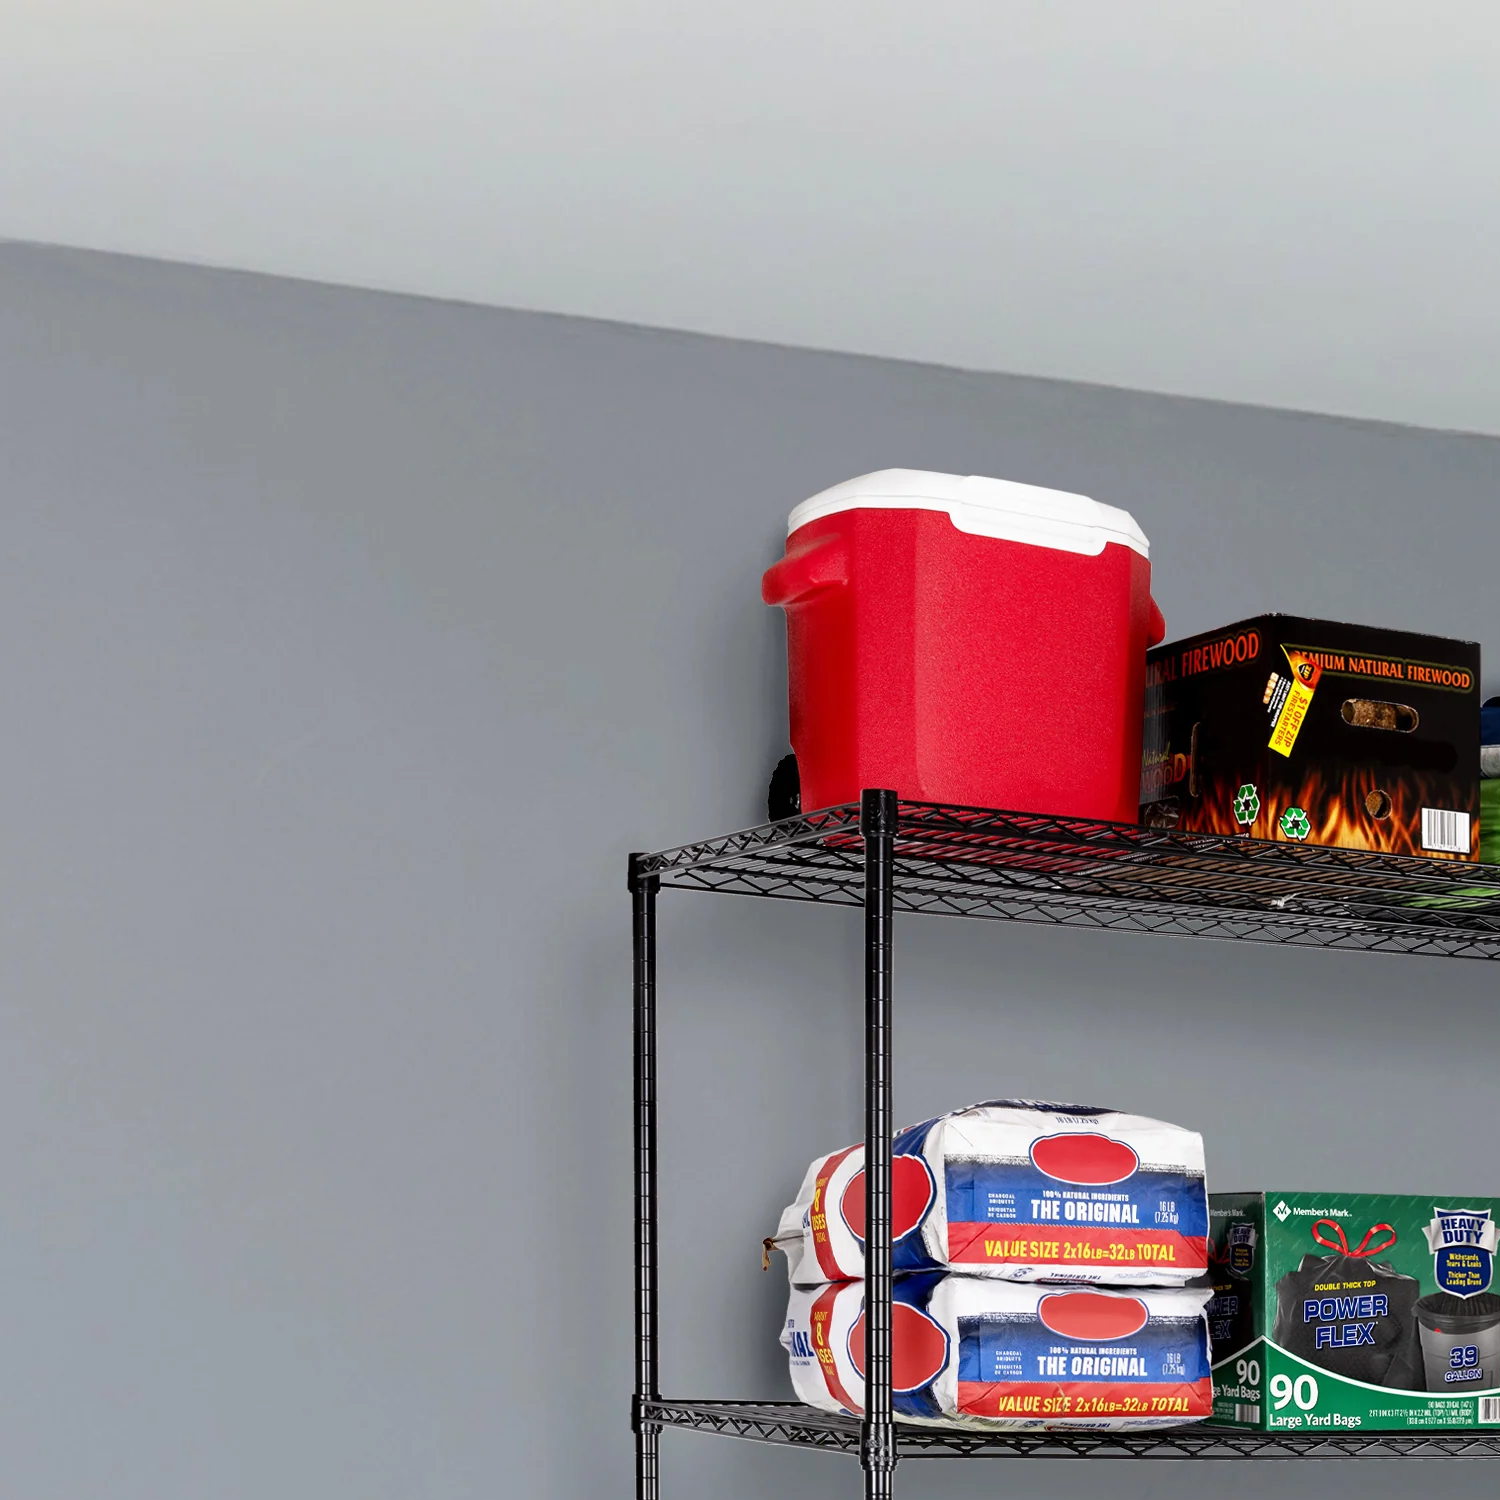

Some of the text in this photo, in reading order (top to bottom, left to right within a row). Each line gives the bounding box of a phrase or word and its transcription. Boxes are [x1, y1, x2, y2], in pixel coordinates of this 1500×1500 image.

[1181, 632, 1259, 677] FIREWOOD
[1297, 651, 1470, 688] MIUM NATURAL FIREWOOD
[1275, 690, 1300, 746] FIRESTARTERS
[1284, 696, 1308, 748] $1 OFF ZIP
[814, 1188, 821, 1212] 8
[1043, 1190, 1130, 1202] 100% NATURAL INGREDIENTS
[1031, 1199, 1140, 1224] THE ORIGINAL
[1160, 1201, 1175, 1212] 16 LB
[1293, 1208, 1329, 1216] Member's
[812, 1213, 826, 1231] USES
[1155, 1211, 1179, 1224] (7.25 kg)
[1441, 1218, 1485, 1231] HEAVY
[1233, 1234, 1250, 1243] DUTY
[1443, 1229, 1483, 1244] DUTY
[985, 1240, 1027, 1258] VALUE
[1030, 1241, 1059, 1258] SIZE
[1137, 1243, 1176, 1261] TOTAL
[1449, 1253, 1479, 1261] Withstands
[1446, 1278, 1482, 1287] Leading Brand
[1448, 1271, 1480, 1279] Thicker Than
[1314, 1280, 1377, 1291] DOUBLE THICK TOP
[1303, 1293, 1388, 1323] POWER
[816, 1322, 823, 1346] 8
[1315, 1321, 1376, 1349] FLEX
[1070, 1347, 1097, 1355] NATURAL
[1098, 1347, 1137, 1355] INGREDIENTS
[1174, 1353, 1181, 1363] LB
[1450, 1344, 1479, 1368] 39
[1037, 1356, 1148, 1377] THE ORIGINAL
[1176, 1363, 1186, 1376] kg)
[1236, 1359, 1260, 1386] 90
[1445, 1368, 1483, 1382] GALLON
[1221, 1384, 1239, 1398] Yard
[1241, 1386, 1260, 1402] Bags
[1269, 1373, 1319, 1411] 90
[999, 1396, 1041, 1412] VALUE
[1043, 1396, 1072, 1412] SIZE
[1150, 1397, 1189, 1412] TOTAL
[1269, 1413, 1362, 1429] Large Yard Bags
